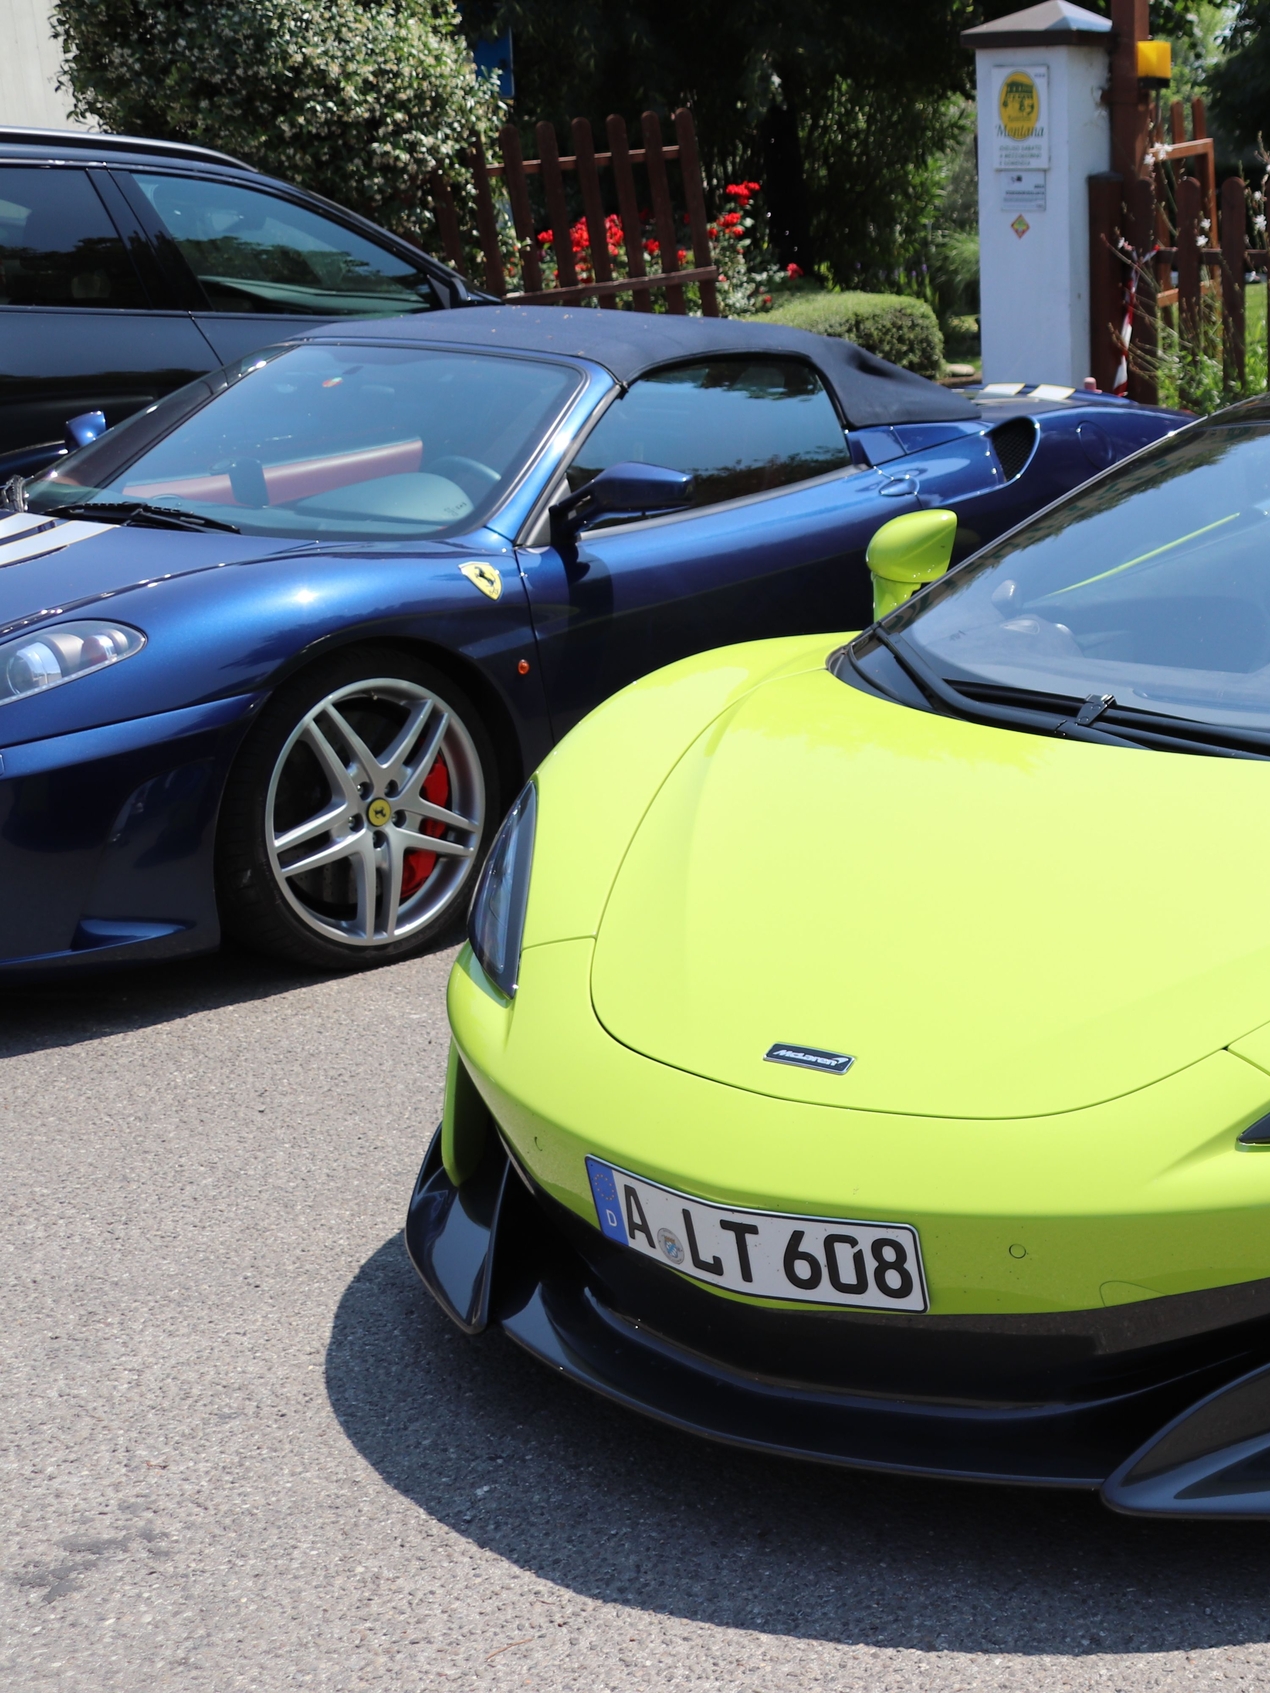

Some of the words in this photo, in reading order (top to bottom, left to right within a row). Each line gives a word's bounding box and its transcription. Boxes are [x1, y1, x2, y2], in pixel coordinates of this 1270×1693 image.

[773, 1049, 838, 1067] McLaren
[605, 1209, 617, 1227] D
[623, 1184, 657, 1249] A
[681, 1208, 760, 1283] LT
[783, 1230, 914, 1299] 608
